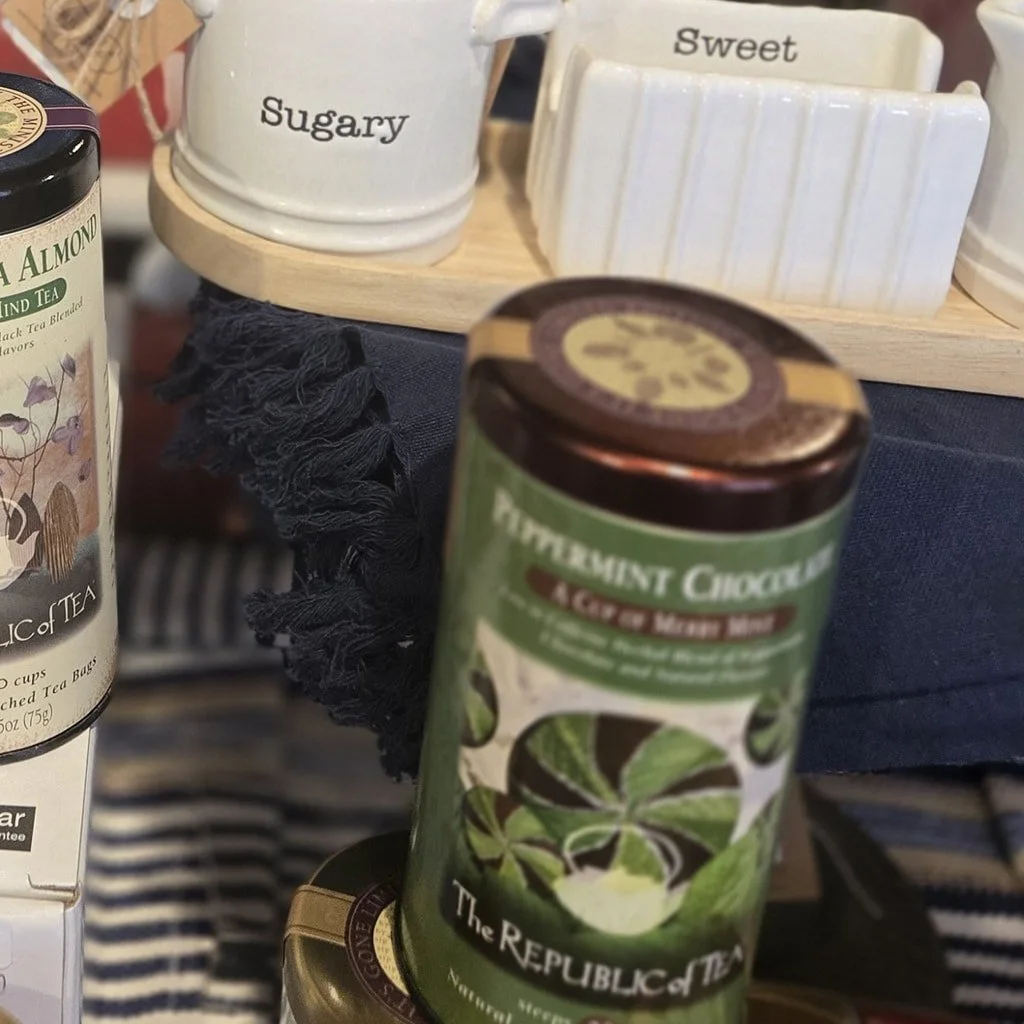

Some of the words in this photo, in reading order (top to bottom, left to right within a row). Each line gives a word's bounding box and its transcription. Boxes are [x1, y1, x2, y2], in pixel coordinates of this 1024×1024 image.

[673, 27, 798, 63] Sweet
[6, 95, 35, 114] THE
[260, 95, 410, 145] Sugary
[18, 213, 98, 283] ALMOND
[34, 287, 59, 307] TEA
[26, 321, 46, 335] Tea
[50, 298, 83, 327] Blended
[37, 602, 56, 635] of
[57, 585, 96, 624] TEA
[14, 667, 47, 689] cups
[42, 679, 67, 699] Tea
[72, 656, 97, 683] Bags
[23, 703, 53, 730] (75g)
[453, 878, 495, 943] The
[499, 919, 667, 997] REPUBLIC
[667, 959, 697, 997] of
